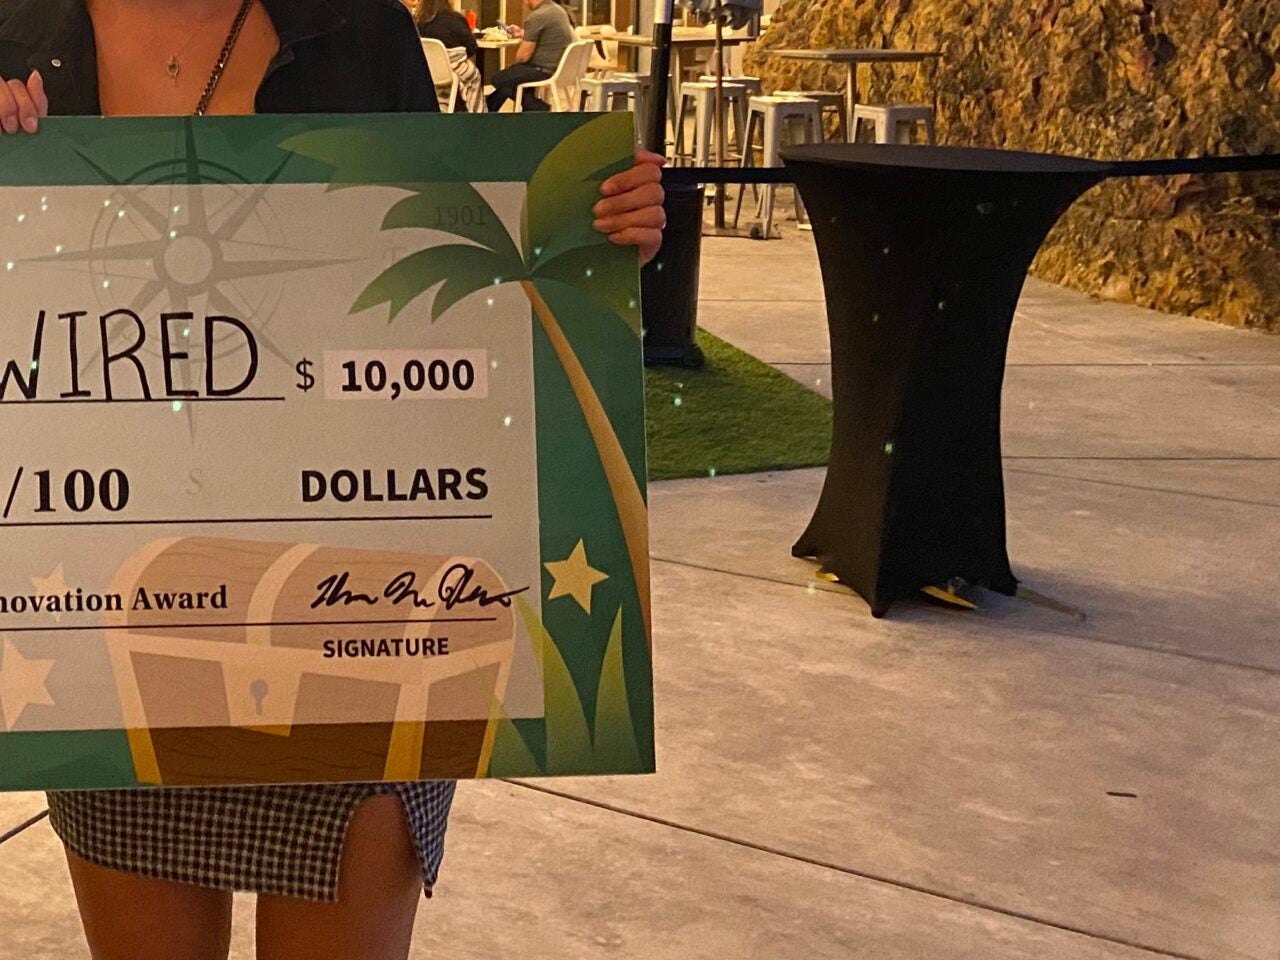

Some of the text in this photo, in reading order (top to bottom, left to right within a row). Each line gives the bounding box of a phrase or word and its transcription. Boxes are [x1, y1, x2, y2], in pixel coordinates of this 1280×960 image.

[295, 357, 475, 401] $ 10,000
[301, 467, 489, 503] DOLLARS
[131, 584, 228, 611] Award
[322, 637, 450, 659] SIGNATURE
